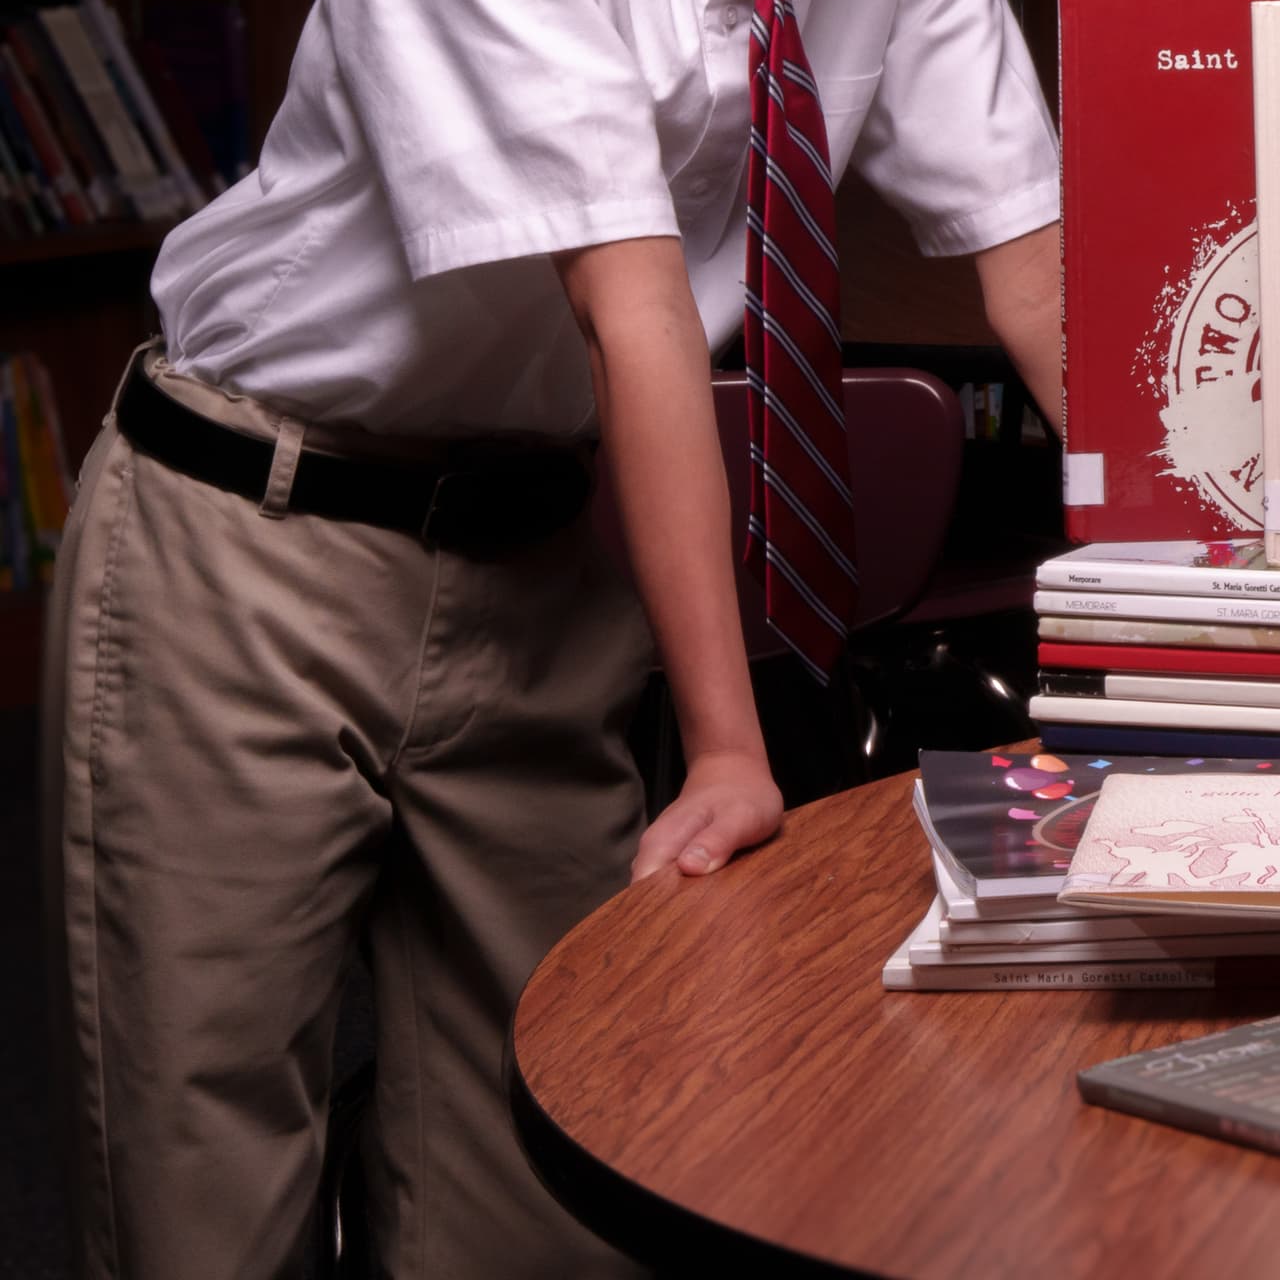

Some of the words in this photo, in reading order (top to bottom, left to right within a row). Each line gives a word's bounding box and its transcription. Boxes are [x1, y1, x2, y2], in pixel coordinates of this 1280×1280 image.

[1157, 48, 1239, 71] Saint
[1068, 574, 1102, 585] Memorare
[1211, 582, 1222, 591] St.
[1223, 582, 1243, 592] Maria
[1245, 583, 1268, 594] Goretti
[1064, 600, 1118, 612] MEMORARE
[1230, 608, 1259, 620] MARIA
[994, 972, 1030, 984] Saint
[1037, 972, 1074, 984] Maria
[1081, 971, 1132, 984] Goretti
[1139, 971, 1200, 984] Catholic
